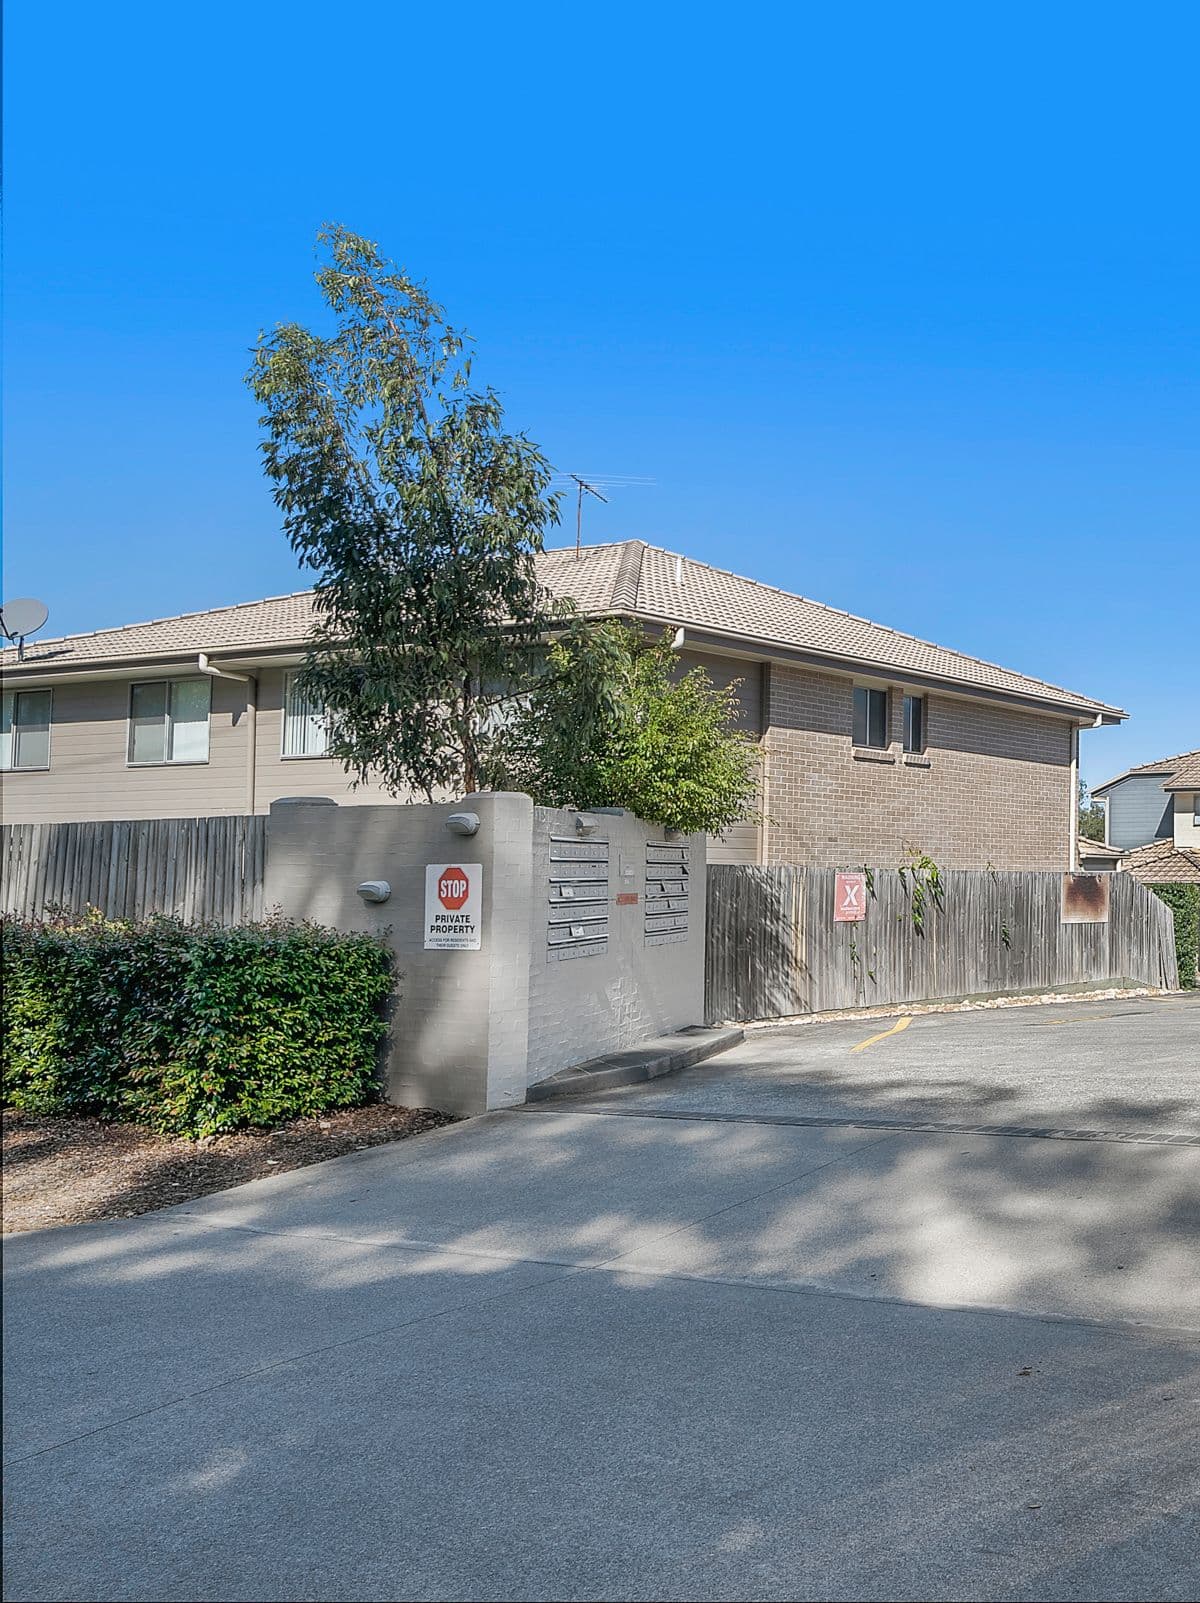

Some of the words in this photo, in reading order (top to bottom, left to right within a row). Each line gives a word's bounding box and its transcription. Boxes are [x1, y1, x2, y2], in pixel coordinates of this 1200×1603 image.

[440, 879, 467, 898] STOP
[435, 914, 471, 923] PRIVATE
[430, 925, 475, 934] PROPERTY
